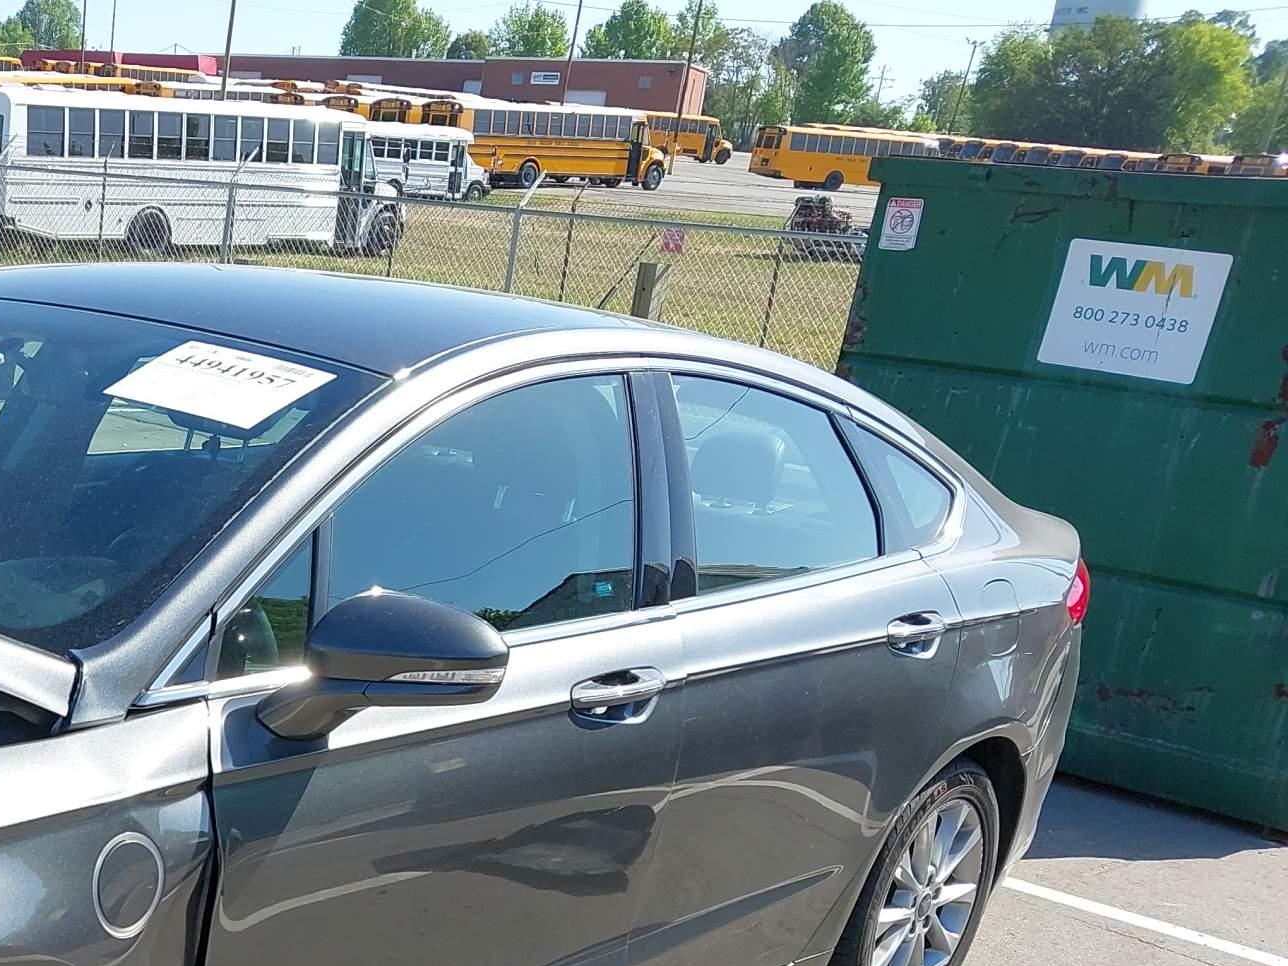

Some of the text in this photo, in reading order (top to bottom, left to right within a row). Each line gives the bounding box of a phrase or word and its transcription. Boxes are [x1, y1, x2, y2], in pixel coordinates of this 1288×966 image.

[897, 200, 922, 208] DANGER
[1089, 254, 1194, 298] WM
[1072, 305, 1189, 333] 800 273 0438
[1083, 340, 1160, 363] wm.com
[175, 354, 297, 389] 44941957
